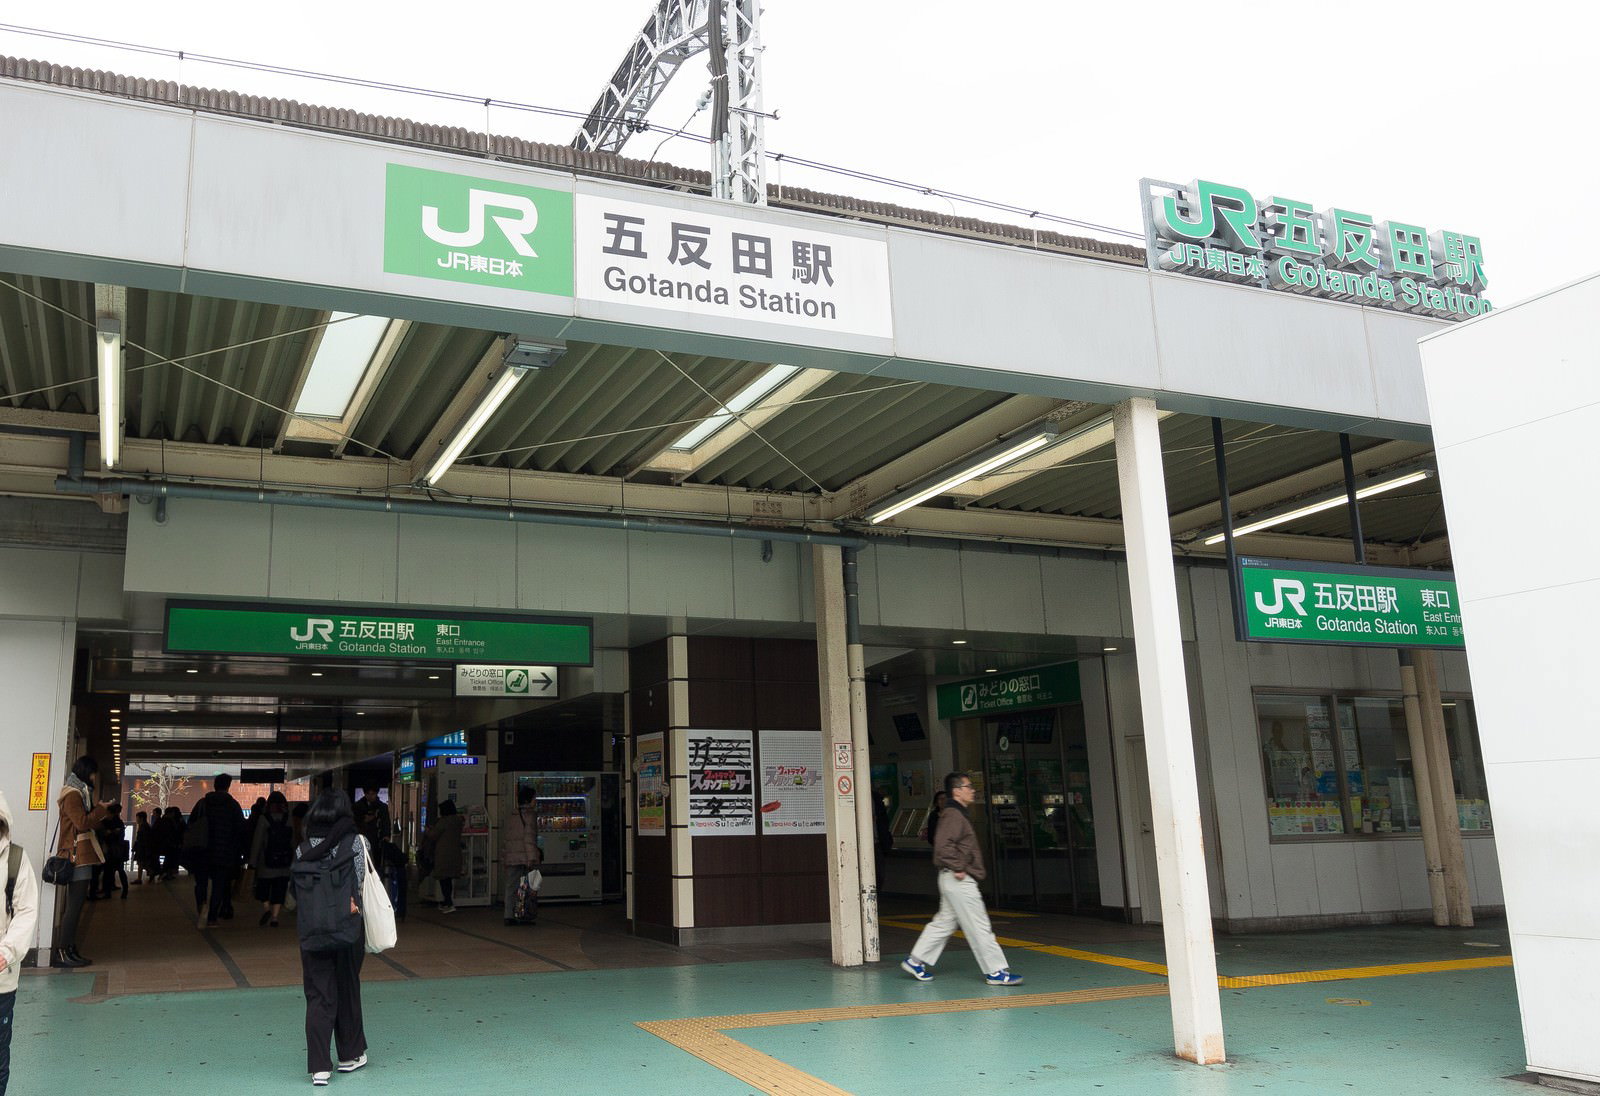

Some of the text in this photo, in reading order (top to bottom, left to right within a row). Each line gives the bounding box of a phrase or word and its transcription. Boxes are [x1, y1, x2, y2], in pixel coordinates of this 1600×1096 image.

[421, 188, 539, 258] JR
[1163, 179, 1263, 250] JR
[602, 211, 834, 287] 五反田駅
[1272, 196, 1488, 291] 五反田駅
[437, 252, 524, 278] JR東日本
[1169, 243, 1266, 279] JR東日本
[604, 266, 837, 320] Gotanda Station
[1277, 256, 1493, 316] Gotanda Station
[1254, 578, 1308, 617] JR
[1312, 582, 1400, 614] 五反田駅
[1420, 589, 1450, 608] 東口
[1264, 617, 1303, 629] JR東日本
[1316, 615, 1418, 635] Gotanda Station
[1423, 610, 1442, 623] East
[290, 618, 334, 642] JR
[339, 620, 415, 641] 五反田駅
[436, 624, 460, 637] 東口
[296, 642, 329, 650] JR東日本
[338, 641, 427, 655] Gotanda Station
[454, 638, 485, 647] Entrance
[461, 668, 504, 678] みどりの窓口
[979, 674, 1041, 697] みどりの窓口
